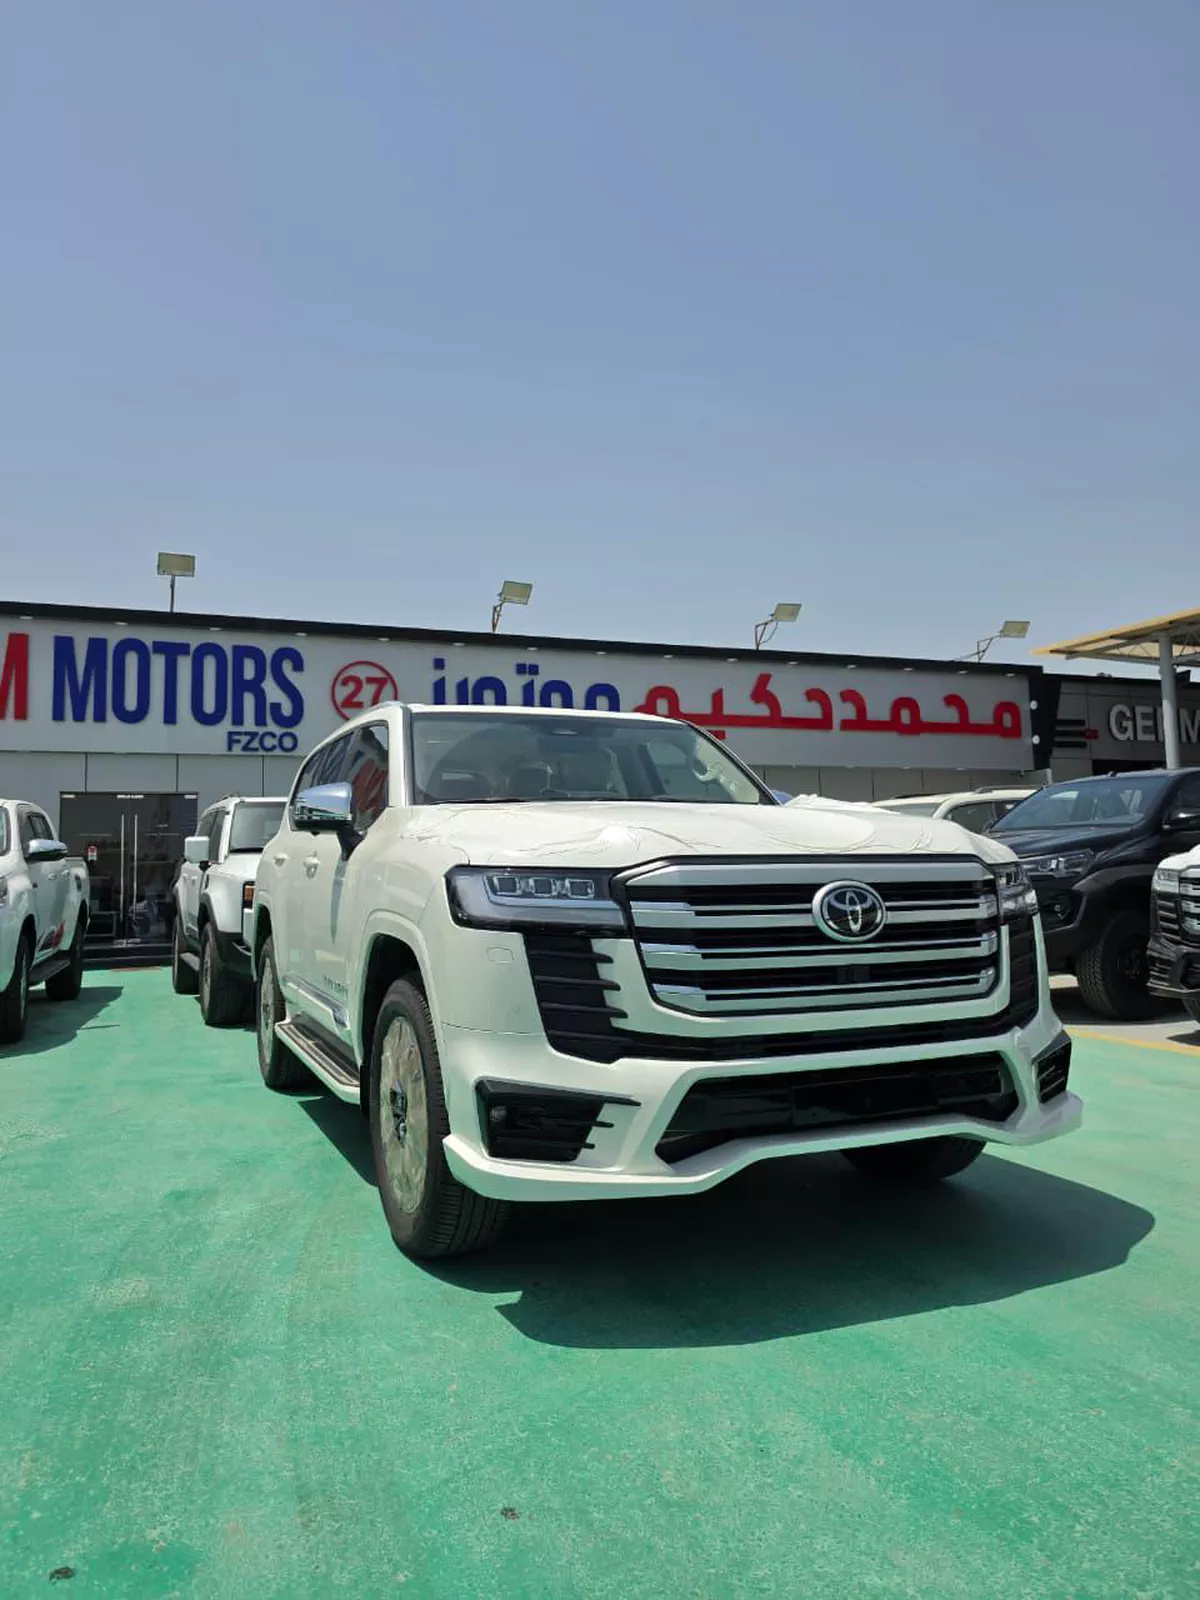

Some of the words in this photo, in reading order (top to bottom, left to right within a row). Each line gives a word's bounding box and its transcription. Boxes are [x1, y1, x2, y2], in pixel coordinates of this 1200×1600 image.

[52, 635, 304, 728] MOTORS
[340, 675, 389, 708] 27
[227, 731, 299, 752] FZCO
